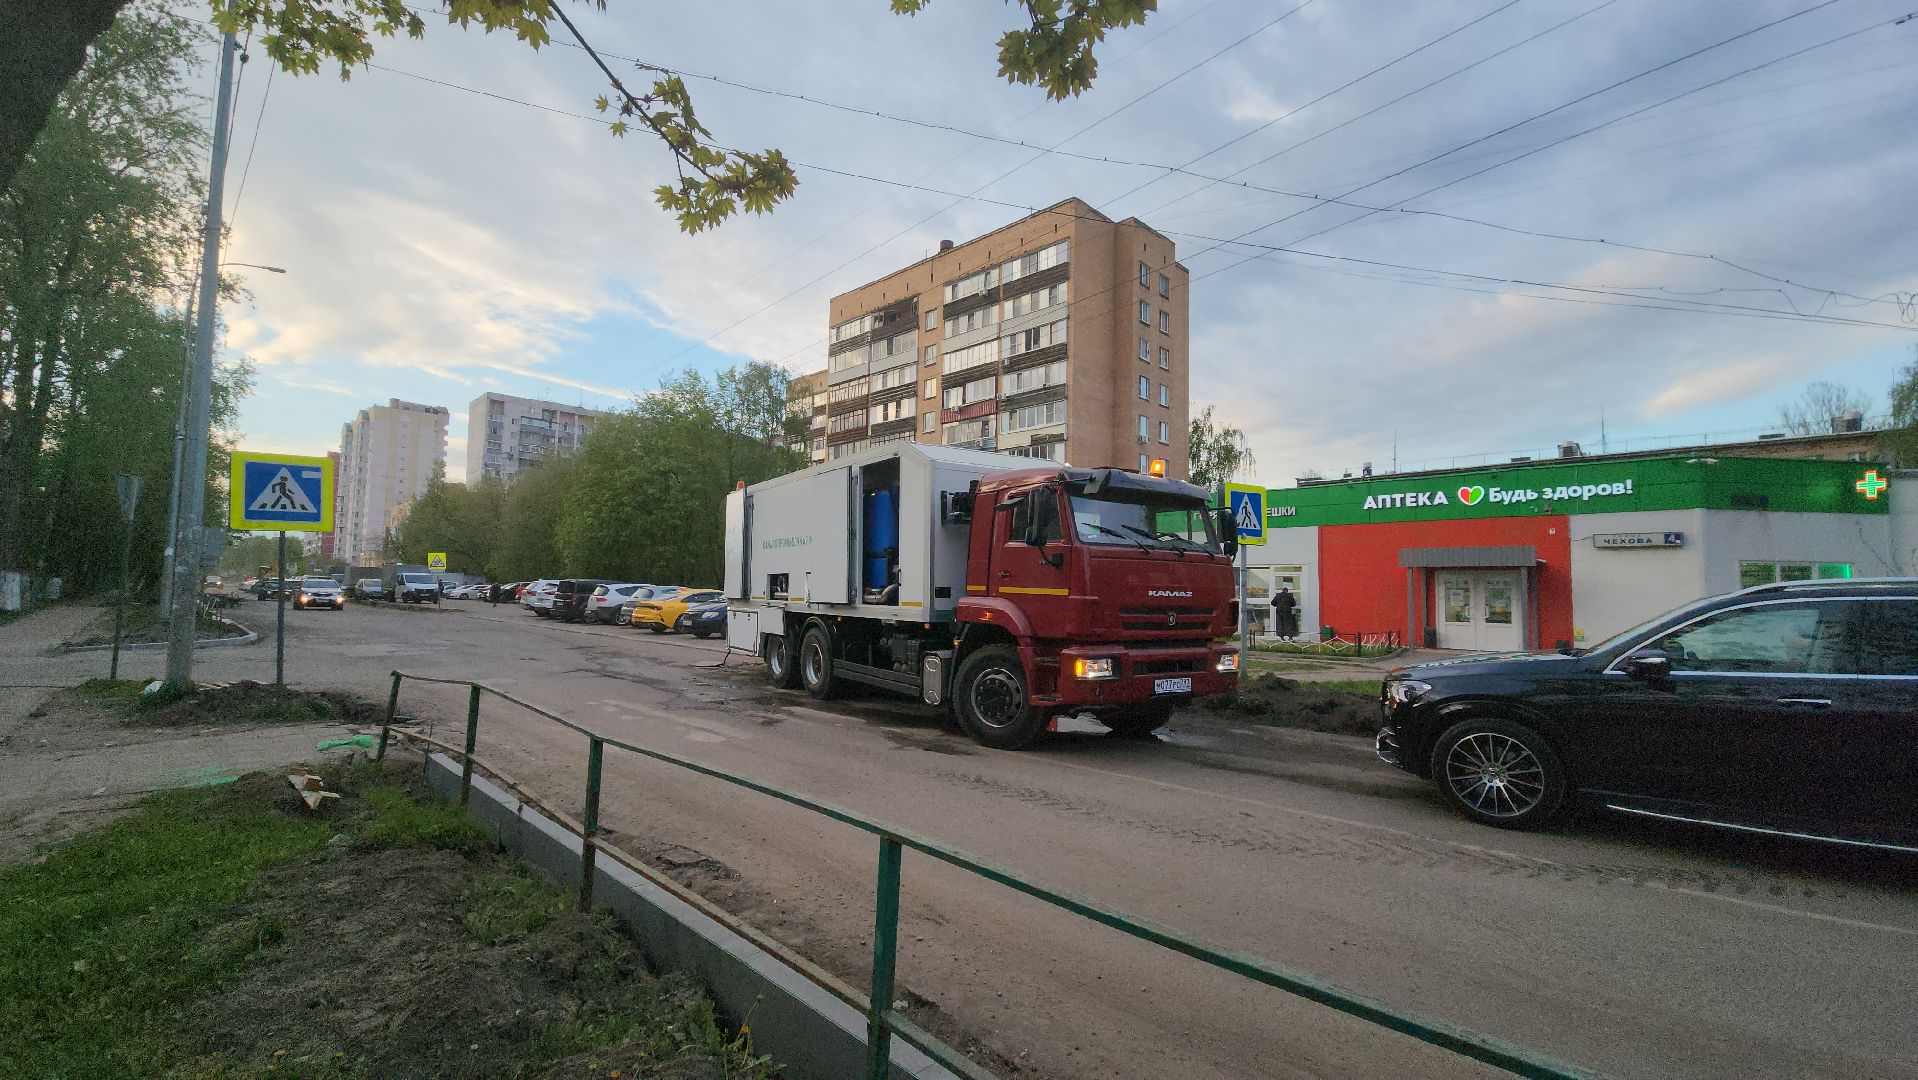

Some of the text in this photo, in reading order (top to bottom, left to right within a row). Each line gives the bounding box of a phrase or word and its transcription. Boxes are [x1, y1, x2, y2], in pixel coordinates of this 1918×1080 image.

[1363, 479, 1633, 510] АПТЕКА Будь здоров!
[1266, 506, 1296, 517] ЕШКИ
